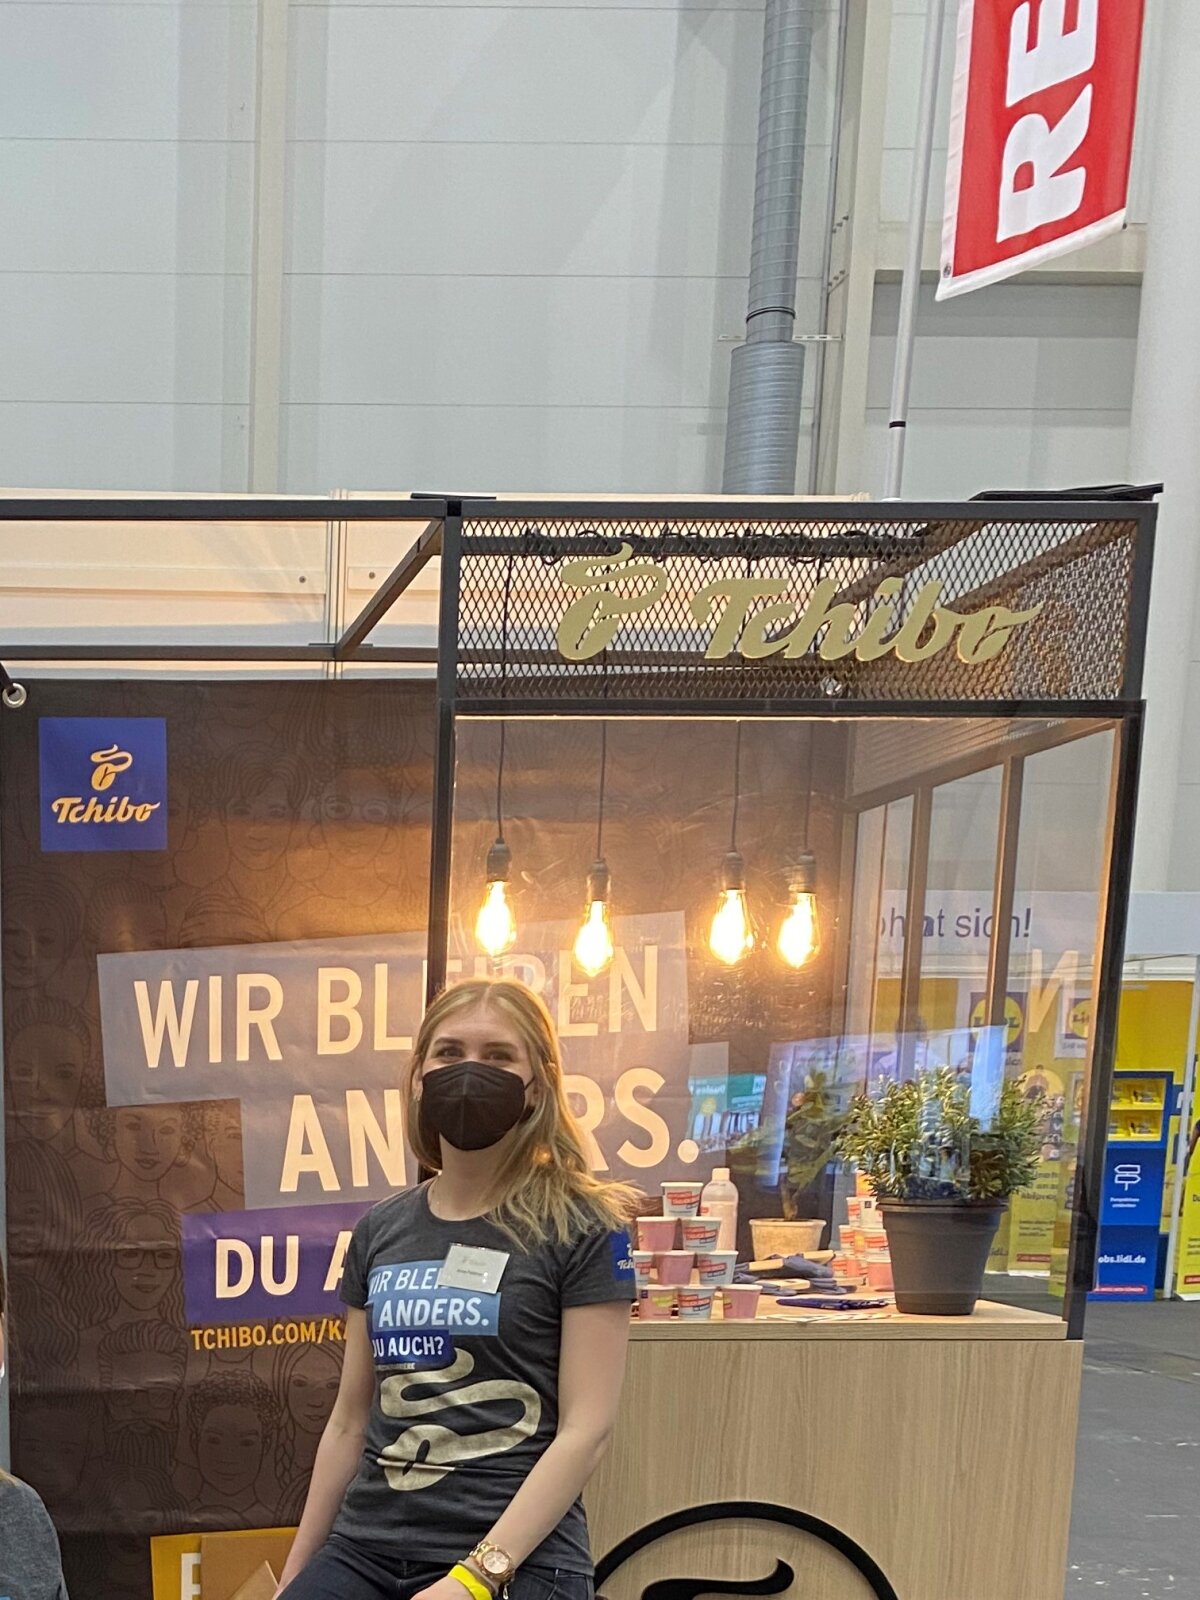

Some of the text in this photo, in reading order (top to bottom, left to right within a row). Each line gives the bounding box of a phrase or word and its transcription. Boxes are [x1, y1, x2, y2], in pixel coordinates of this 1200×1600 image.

[691, 577, 1042, 664] Tchibo
[52, 796, 161, 824] Tchibo
[134, 973, 285, 1069] WIR
[216, 1235, 299, 1298] DU
[378, 1297, 490, 1328] ANDERS.
[191, 1318, 348, 1350] TCHIBO.COM/K
[388, 1335, 444, 1357] AUCH?
